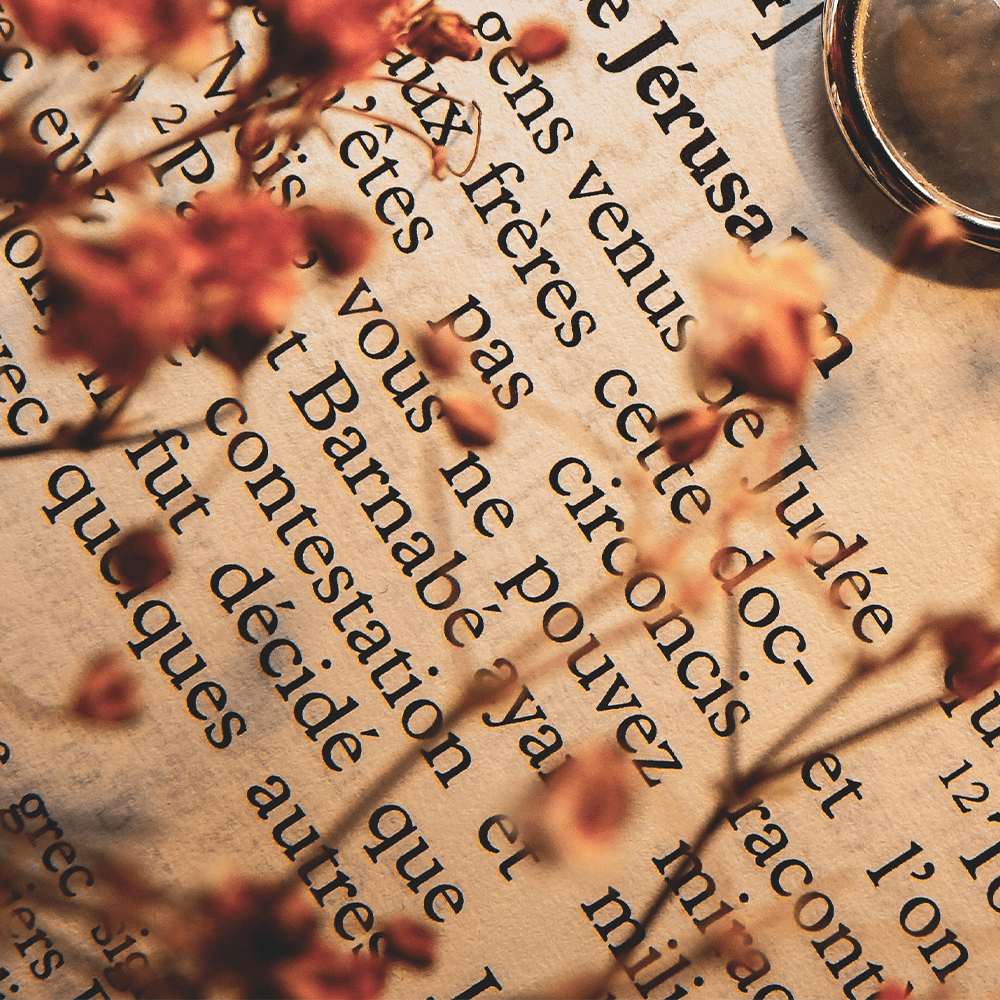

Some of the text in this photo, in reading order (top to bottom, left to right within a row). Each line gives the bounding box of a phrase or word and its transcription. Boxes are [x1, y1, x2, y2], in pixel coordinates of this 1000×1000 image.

[288, 359, 502, 649] Barnabé
[337, 276, 459, 434] vous
[438, 441, 515, 539] ne
[494, 554, 683, 789] pouvez
[425, 293, 534, 410] pas
[548, 456, 751, 738] circoncis
[441, 11, 574, 155] gens
[568, 159, 693, 353] venus
[755, 444, 894, 644] Judée
[459, 161, 597, 349] frères
[712, 546, 814, 686] doc-
[124, 427, 465, 942] fut décidé que
[203, 396, 472, 790] contestation
[938, 758, 990, 814] 12
[792, 742, 969, 985] et l'on
